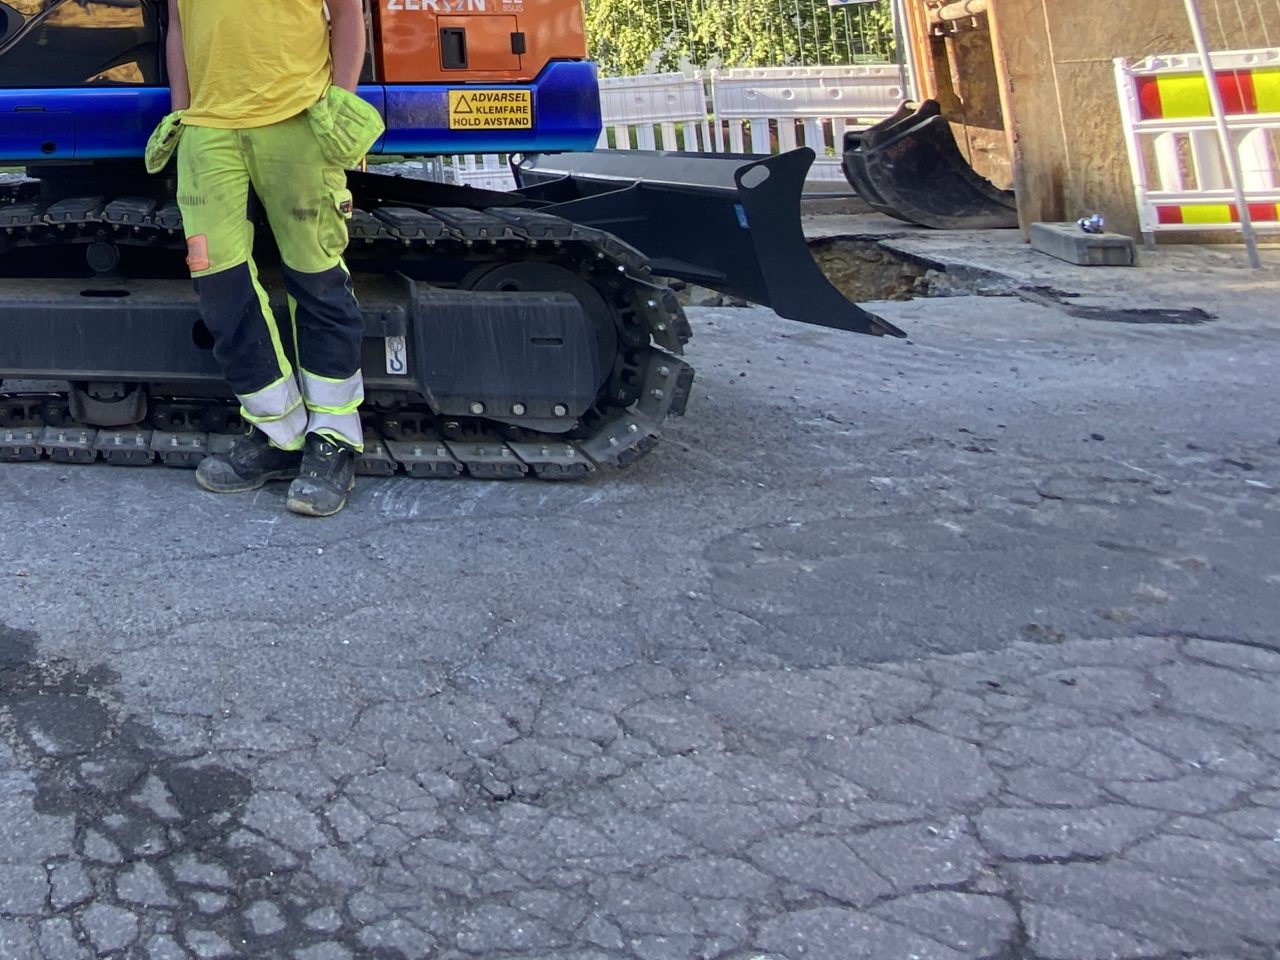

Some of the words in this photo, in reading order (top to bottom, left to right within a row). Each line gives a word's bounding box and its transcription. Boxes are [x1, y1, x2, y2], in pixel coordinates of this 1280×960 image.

[471, 93, 527, 102] ADVARSEL
[476, 106, 528, 114] KLEMFARE
[453, 118, 480, 126] HOLD
[484, 118, 529, 126] AVSTAND
